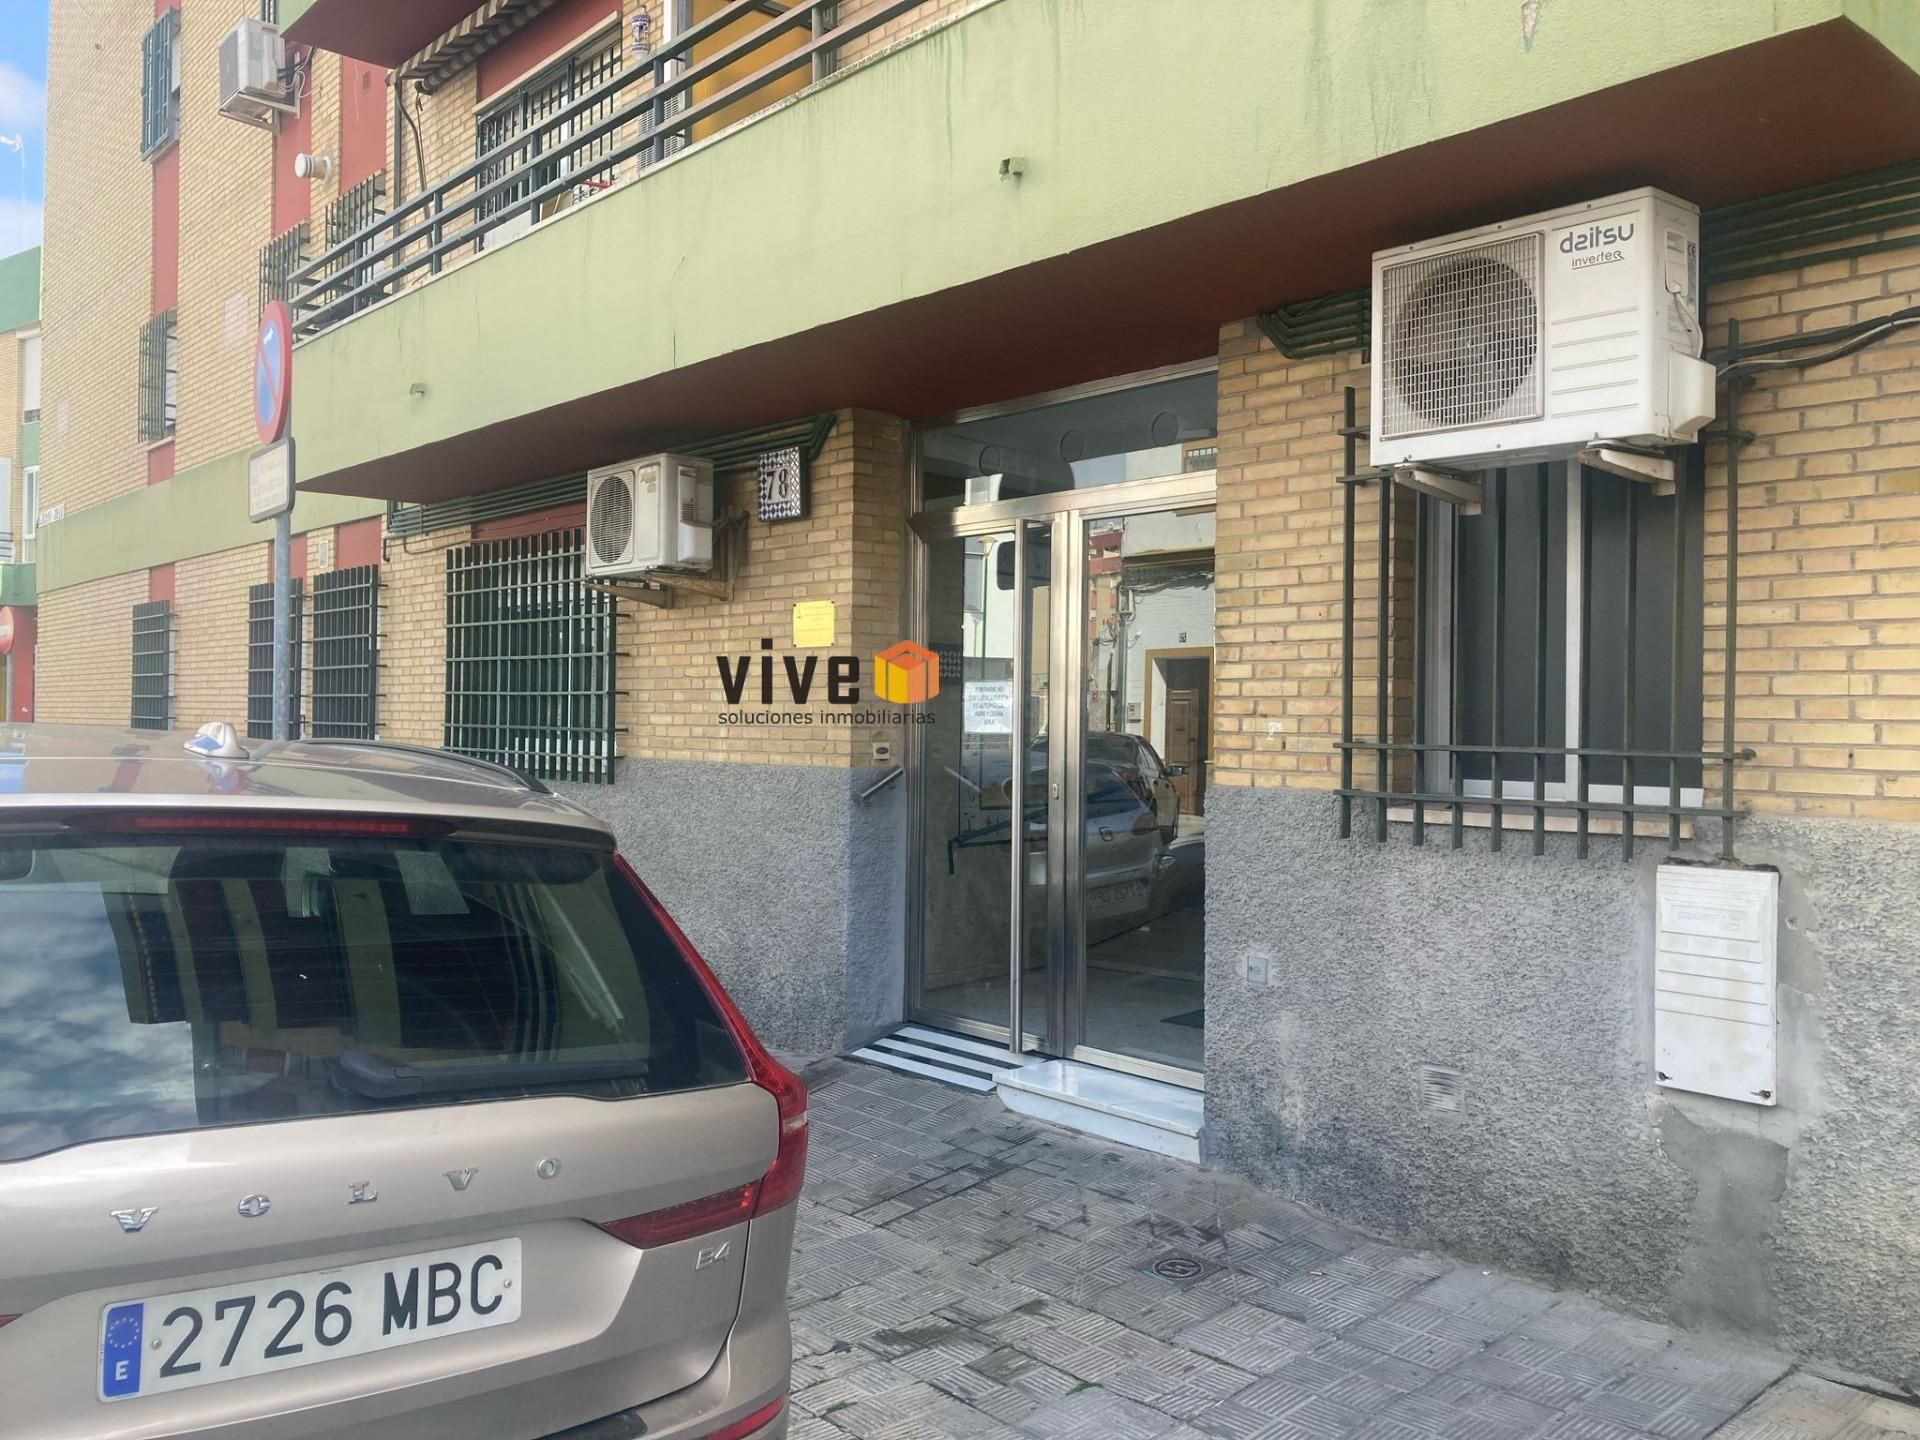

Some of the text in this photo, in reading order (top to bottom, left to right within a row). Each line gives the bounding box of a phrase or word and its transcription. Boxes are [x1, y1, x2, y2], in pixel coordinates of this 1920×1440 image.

[1560, 223, 1634, 254] daitsu
[766, 468, 789, 500] 78
[111, 1157, 562, 1233] VOLVO
[160, 1254, 503, 1378] 2726 MBC
[115, 1360, 129, 1381] E
